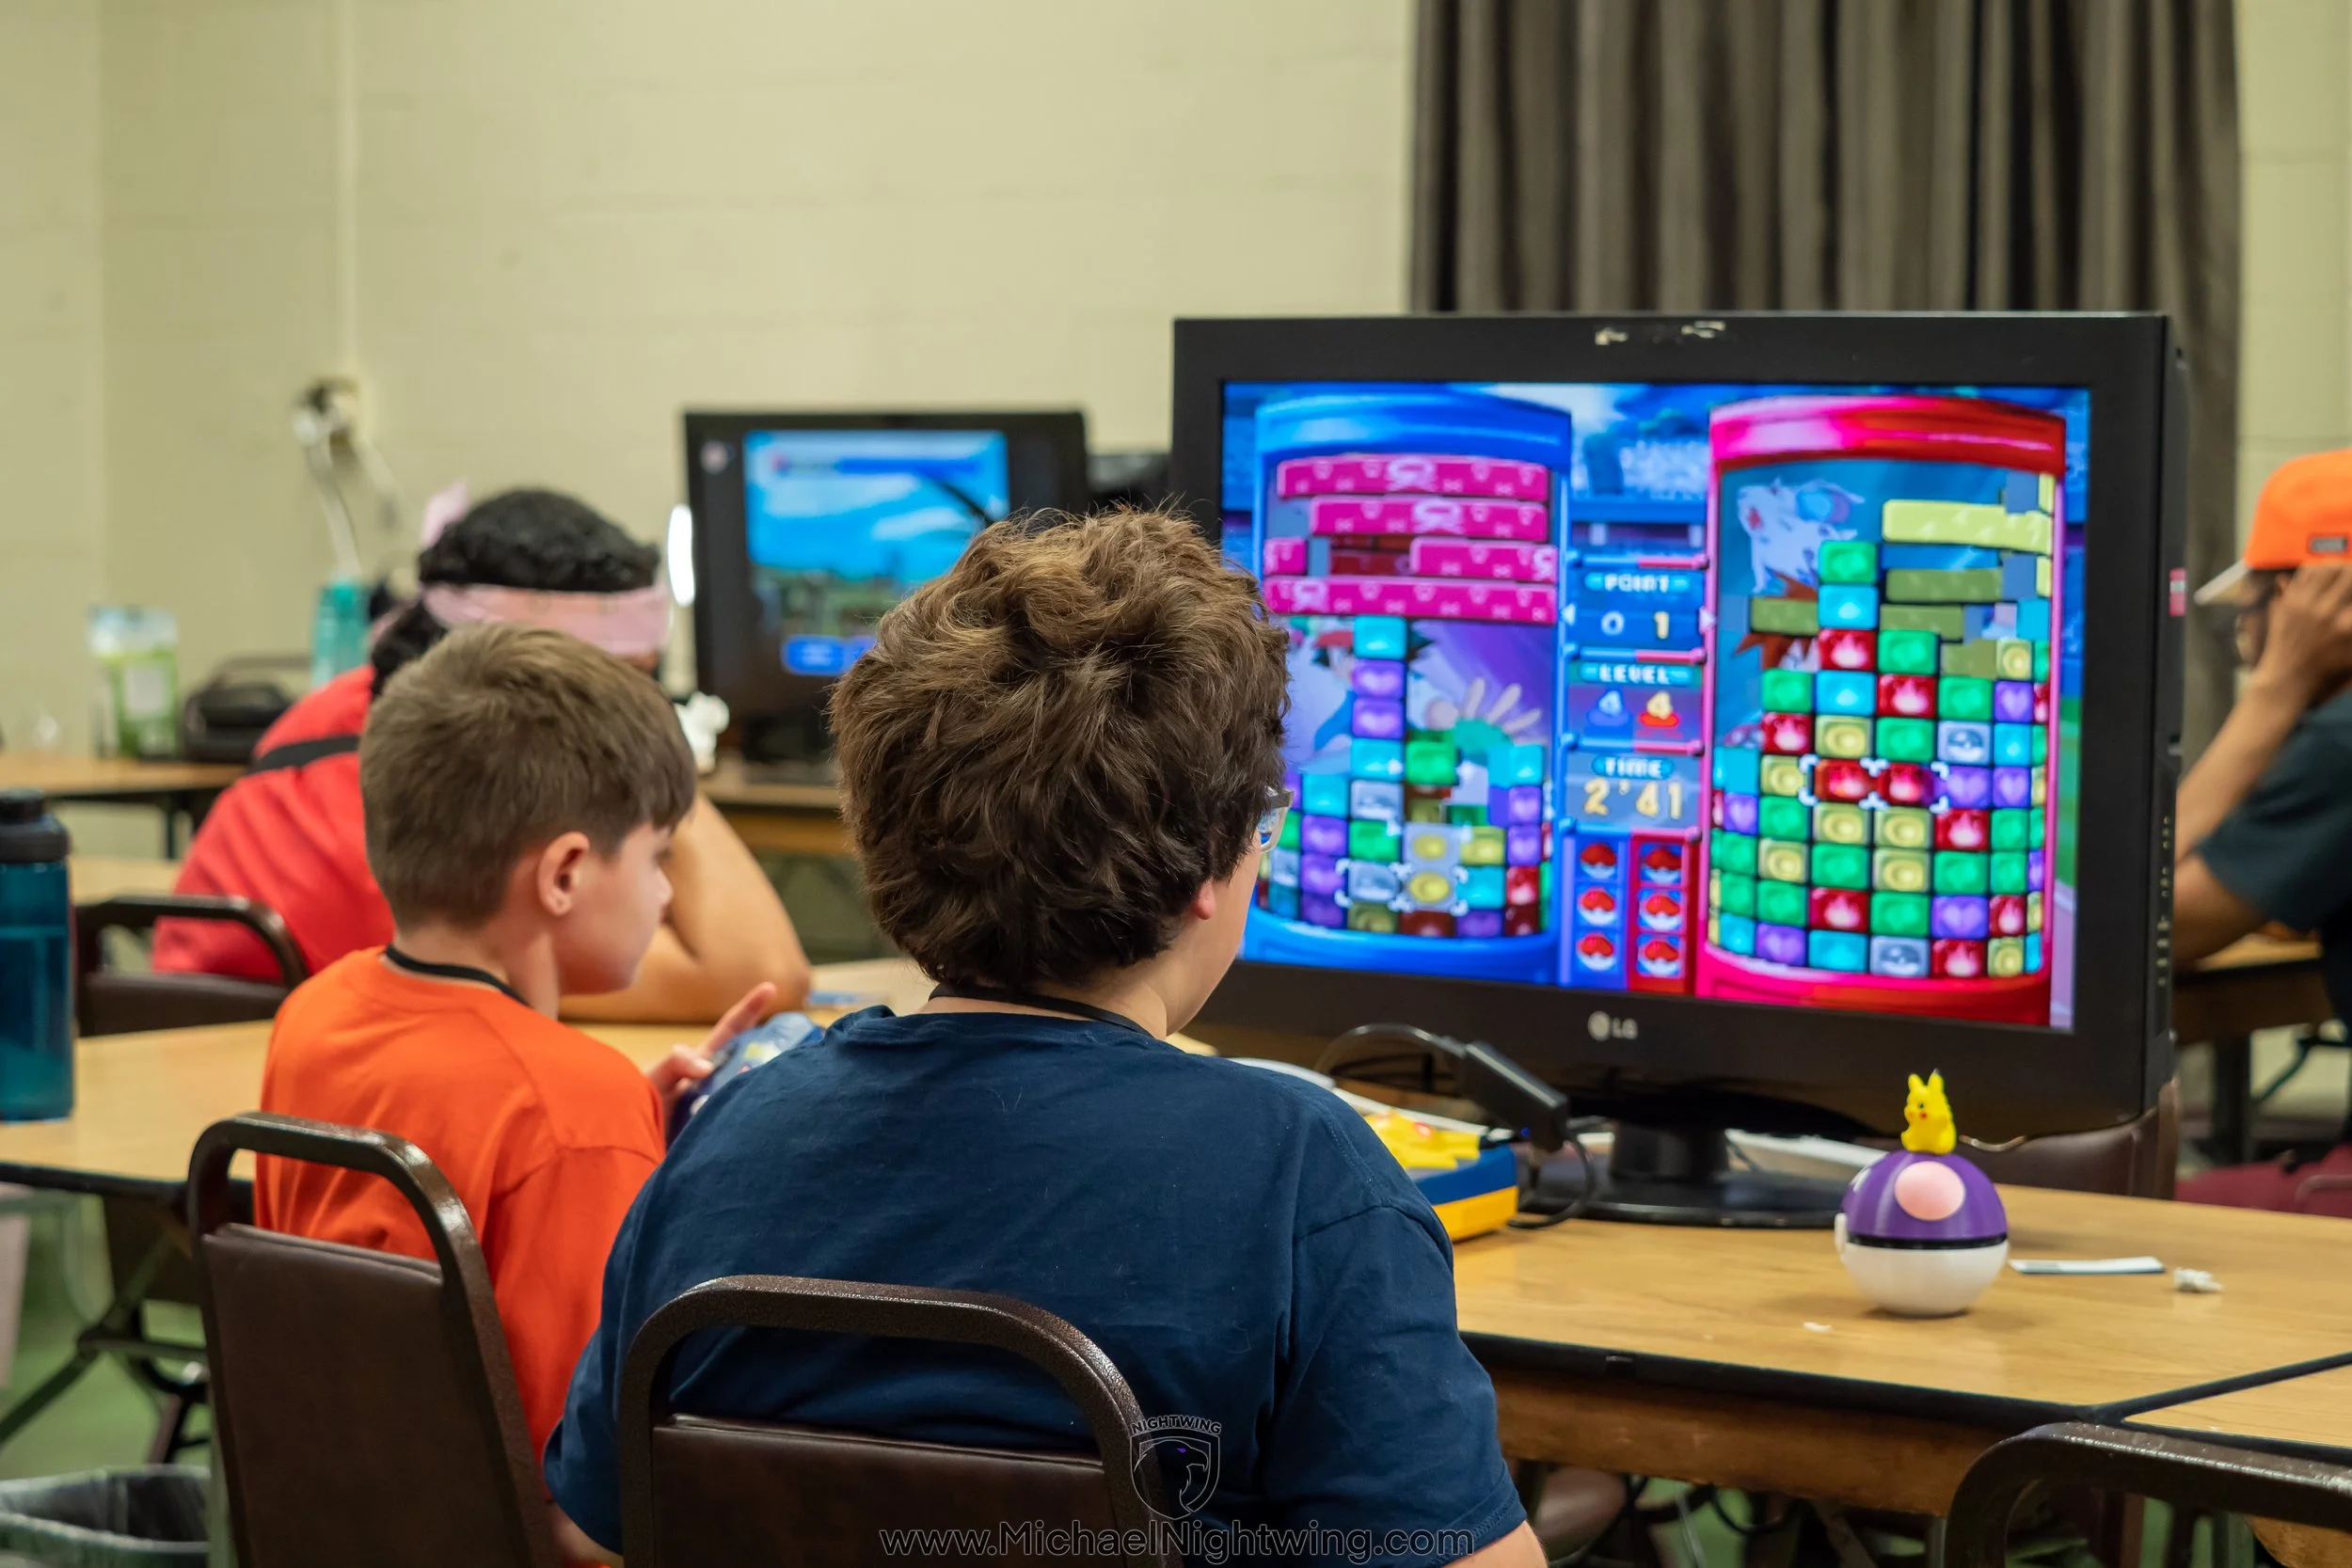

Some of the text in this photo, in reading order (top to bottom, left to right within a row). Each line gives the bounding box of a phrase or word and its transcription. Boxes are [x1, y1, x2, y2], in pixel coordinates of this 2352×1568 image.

[1652, 610, 1670, 640] 1
[1598, 664, 1670, 685] LEVEL
[1646, 690, 1671, 720] 4
[1603, 758, 1663, 777] TIME
